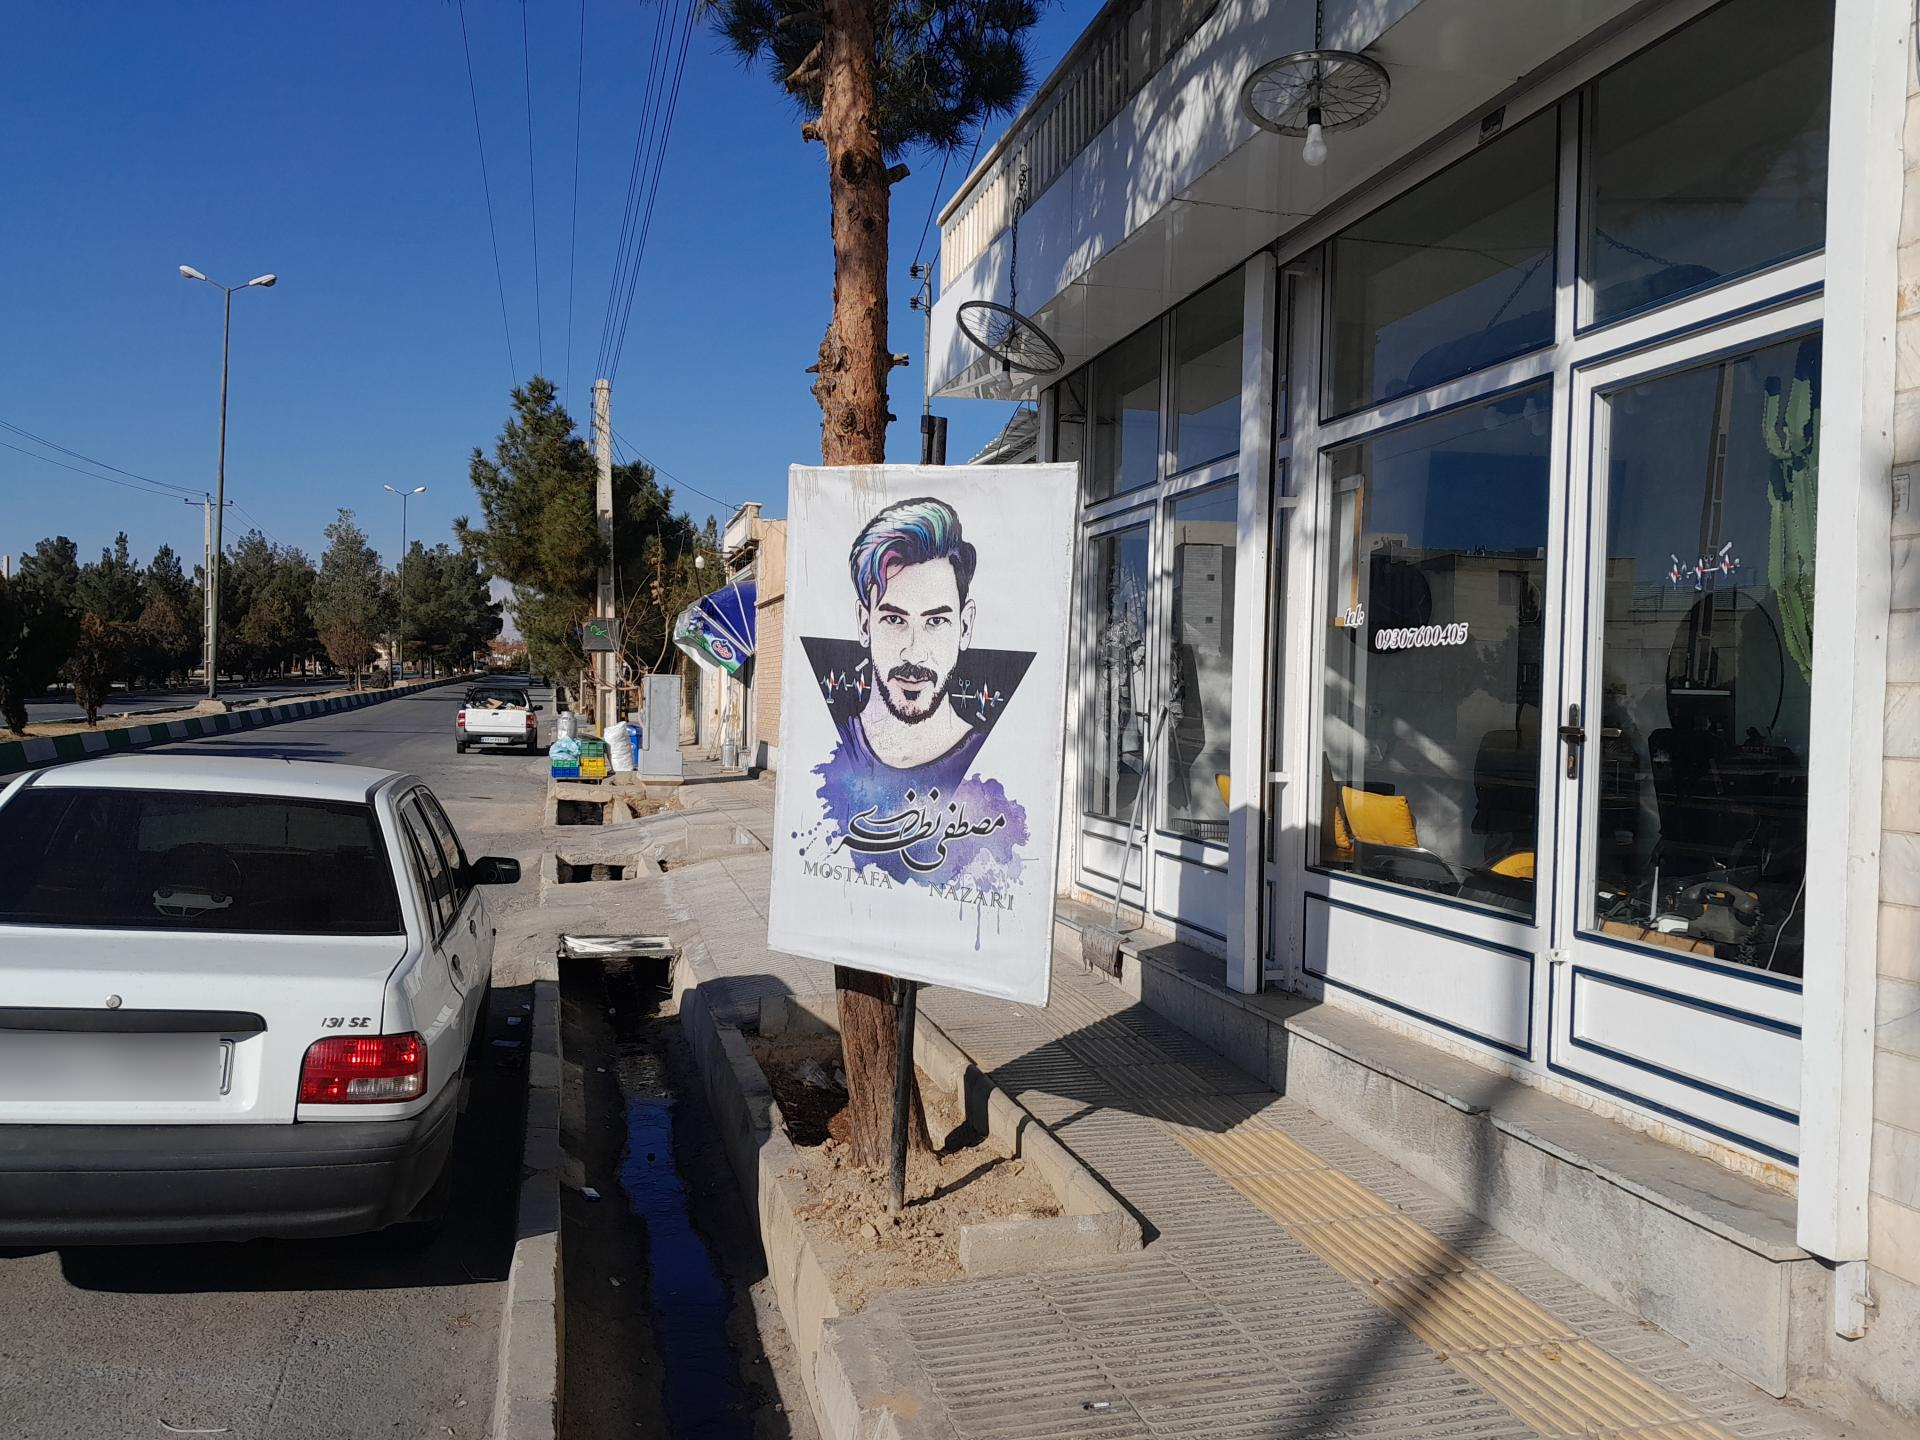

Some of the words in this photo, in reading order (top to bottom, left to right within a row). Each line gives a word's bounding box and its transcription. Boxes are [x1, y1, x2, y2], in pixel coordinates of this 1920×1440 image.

[1344, 603, 1365, 628] tel:
[1375, 622, 1468, 650] 09307600405
[900, 801, 1006, 872] مصطفی
[803, 860, 893, 890] MOSTAFA
[928, 881, 1014, 911] NAZARI
[321, 1017, 345, 1028] 131
[348, 1017, 372, 1028] SE
